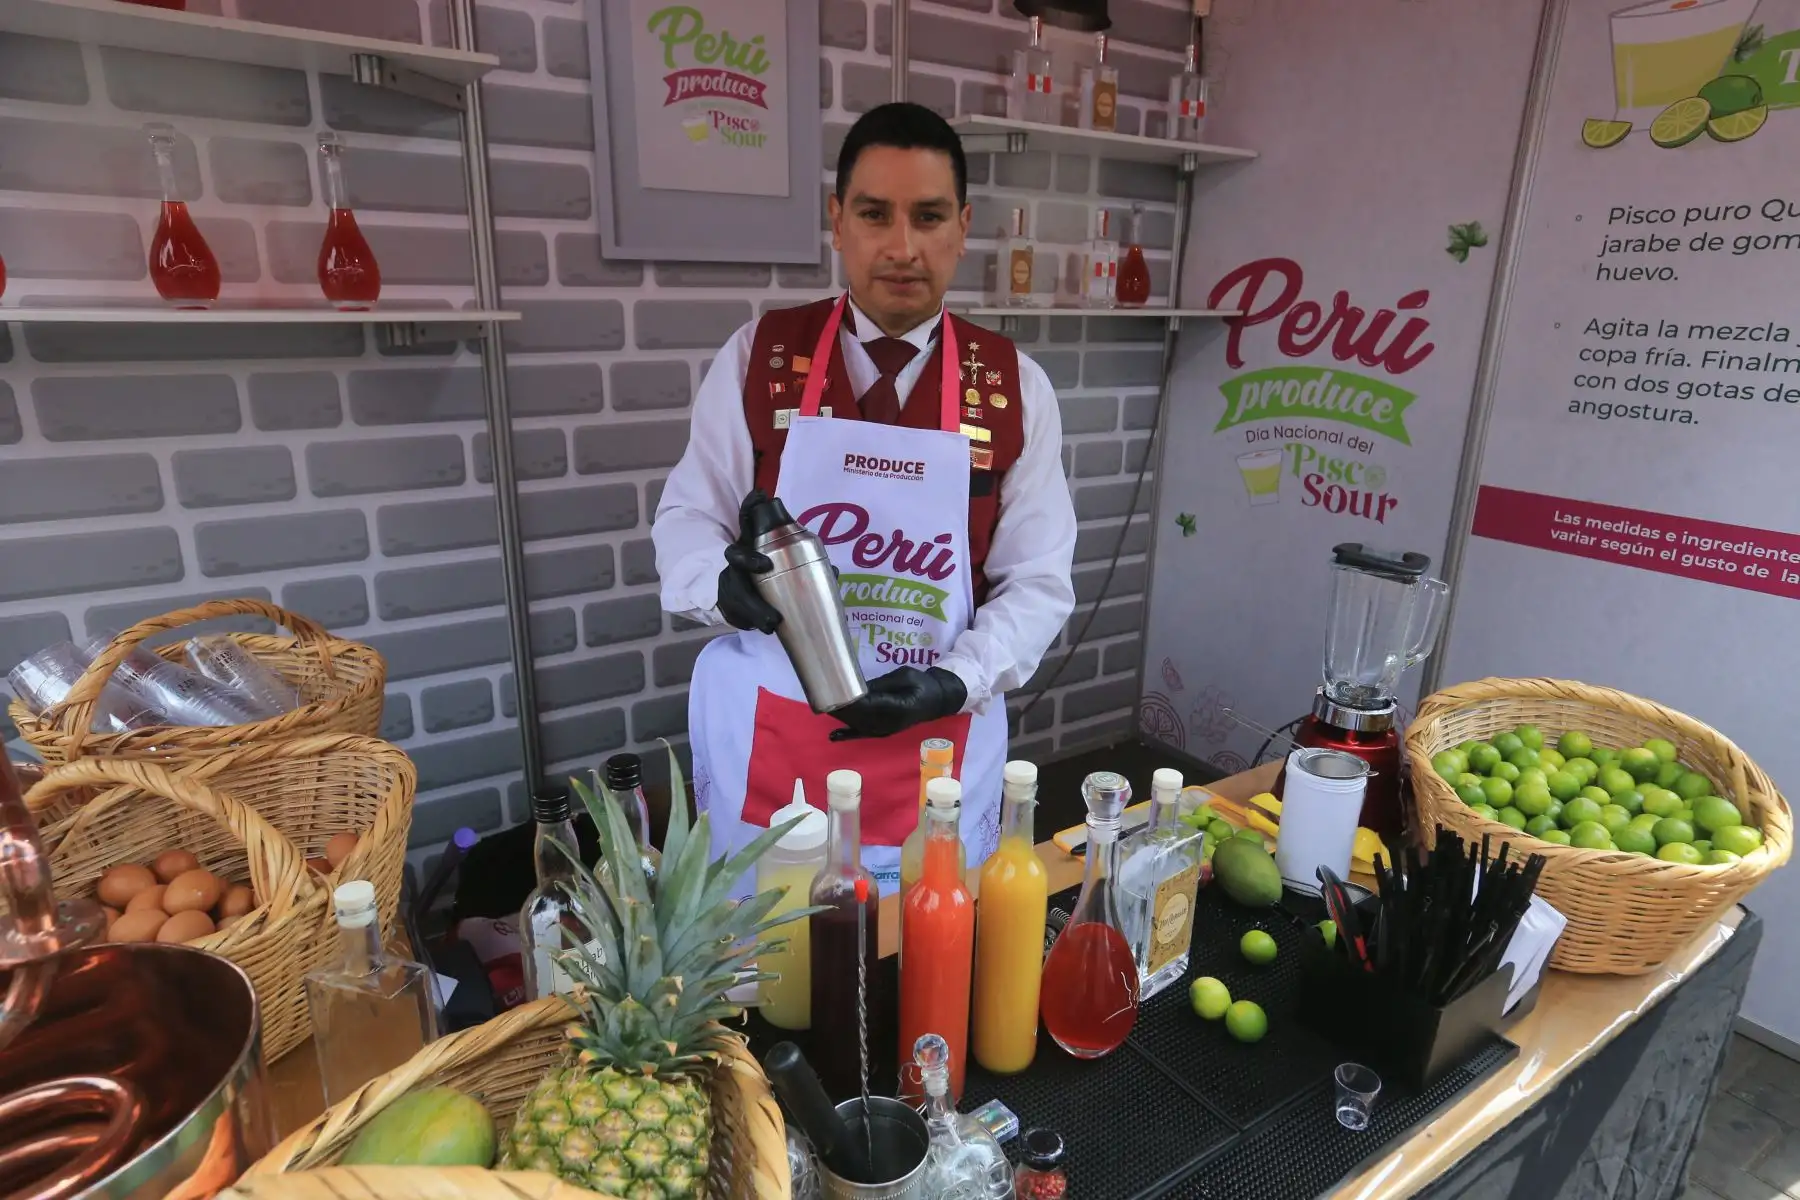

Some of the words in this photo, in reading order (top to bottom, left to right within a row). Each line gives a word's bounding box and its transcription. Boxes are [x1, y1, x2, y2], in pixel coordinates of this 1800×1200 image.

[647, 5, 771, 75] Perú
[672, 71, 761, 101] produce
[1608, 205, 1676, 225] Pisco
[1683, 204, 1751, 227] puro
[1597, 234, 1681, 258] jarabe
[1689, 232, 1724, 251] de
[1596, 262, 1679, 281] huevo.
[1206, 257, 1435, 375] Perú
[1583, 317, 1649, 340] Agita
[1657, 319, 1679, 338] la
[1687, 322, 1790, 343] mezcla
[1578, 347, 1637, 368] copa
[1645, 347, 1692, 367] fría.
[1701, 350, 1800, 374] Finalm
[1229, 371, 1394, 424] produce
[1573, 372, 1617, 391] con
[1624, 374, 1669, 394] dos
[1676, 379, 1755, 401] gotas
[1763, 383, 1800, 403] de
[1568, 399, 1699, 425] angostura.
[1273, 425, 1343, 445] Nacional
[1346, 437, 1375, 455] del
[843, 467, 874, 476] Ministerio
[844, 453, 925, 475] PRODUCE
[1301, 473, 1398, 524] Sour
[1554, 510, 1581, 526] Las
[1585, 515, 1661, 539] medidas
[1665, 530, 1677, 542] e
[797, 502, 956, 581] Perú
[1551, 527, 1597, 546] variar
[1600, 536, 1655, 556] según
[1659, 548, 1677, 561] el
[1680, 552, 1738, 573] gusto
[1743, 563, 1770, 578] de
[840, 578, 937, 609] roduce
[852, 611, 904, 624] Nacional
[906, 616, 924, 627] del
[875, 641, 940, 667] Sour
